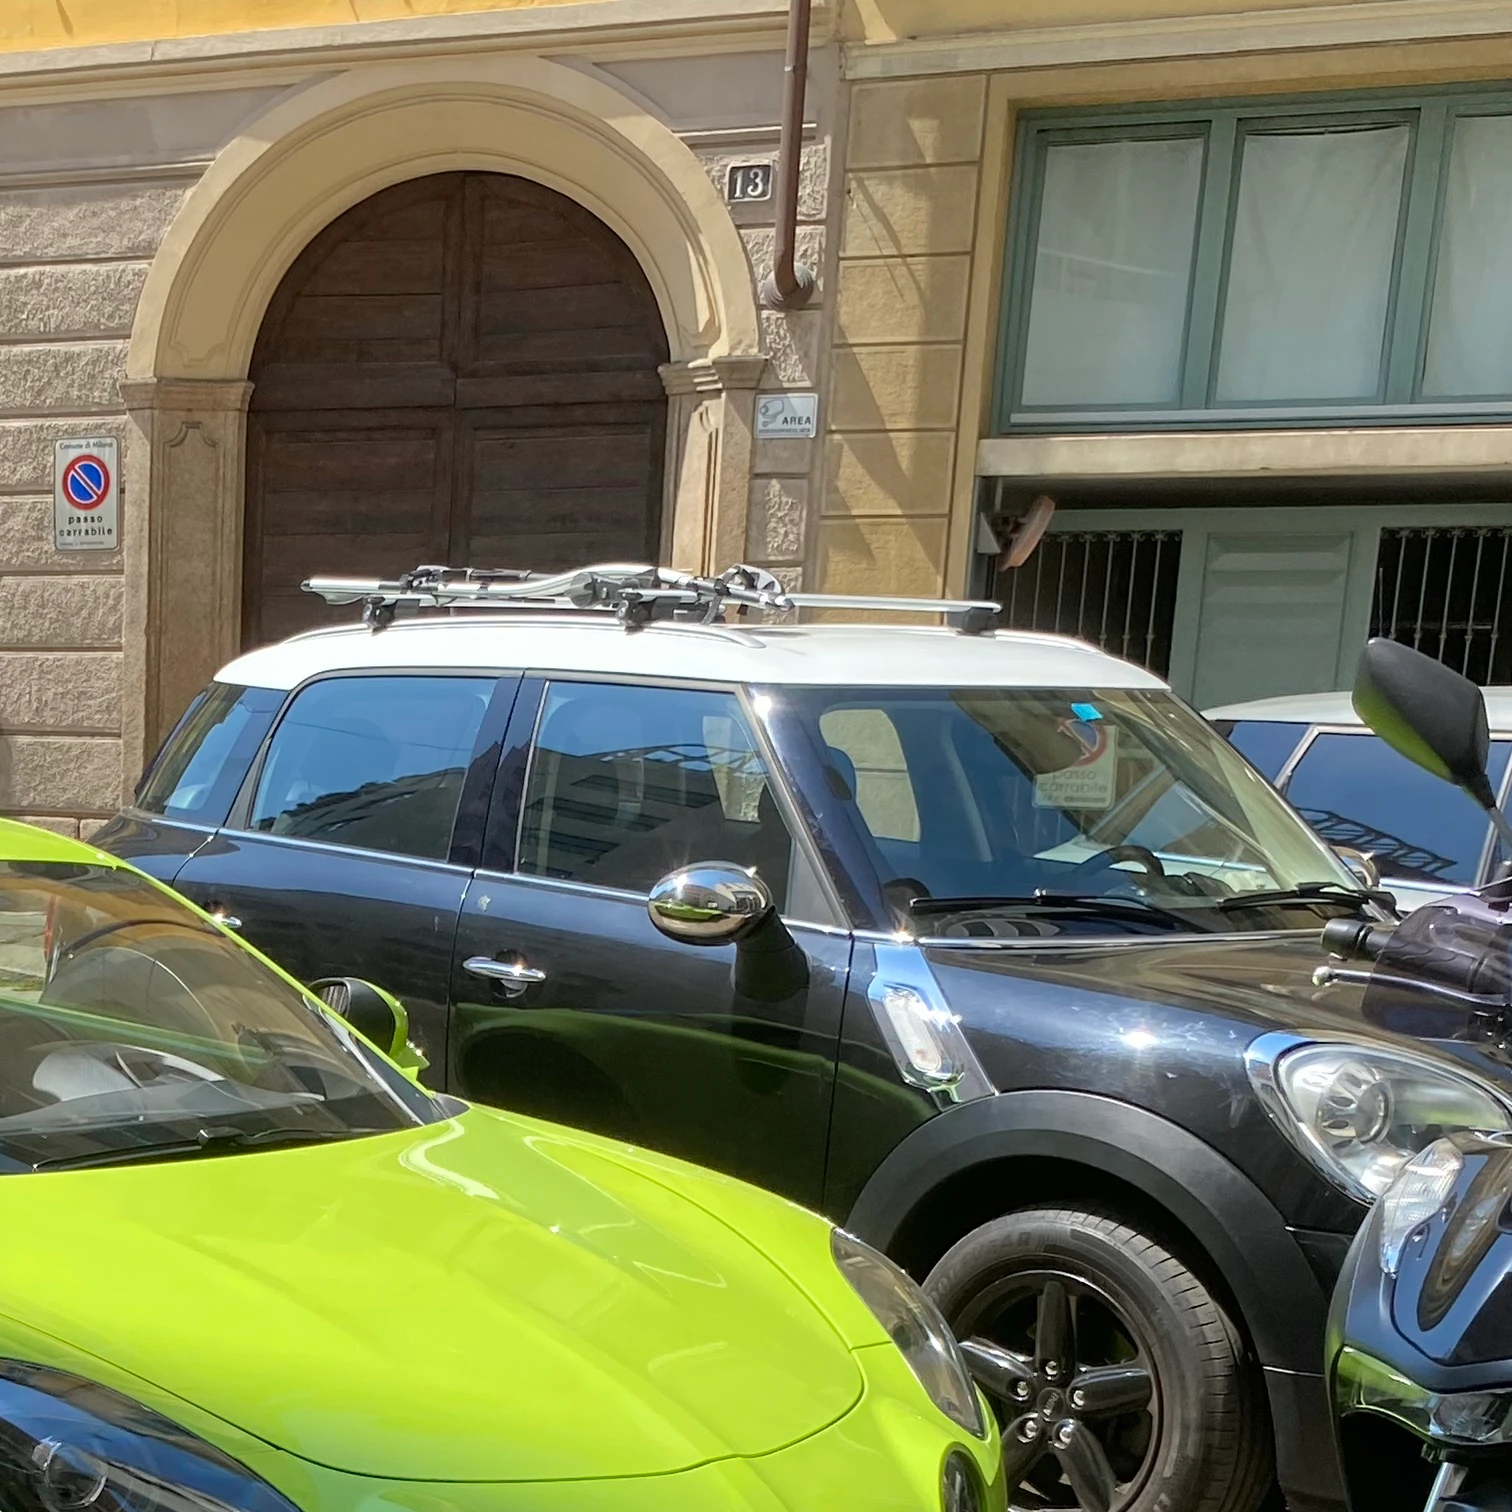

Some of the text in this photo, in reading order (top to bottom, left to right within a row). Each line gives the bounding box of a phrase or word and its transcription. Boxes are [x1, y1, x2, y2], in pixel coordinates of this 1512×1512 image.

[733, 168, 764, 198] 13
[782, 415, 811, 426] AREA
[68, 515, 103, 525] passo
[59, 527, 113, 537] carrabile
